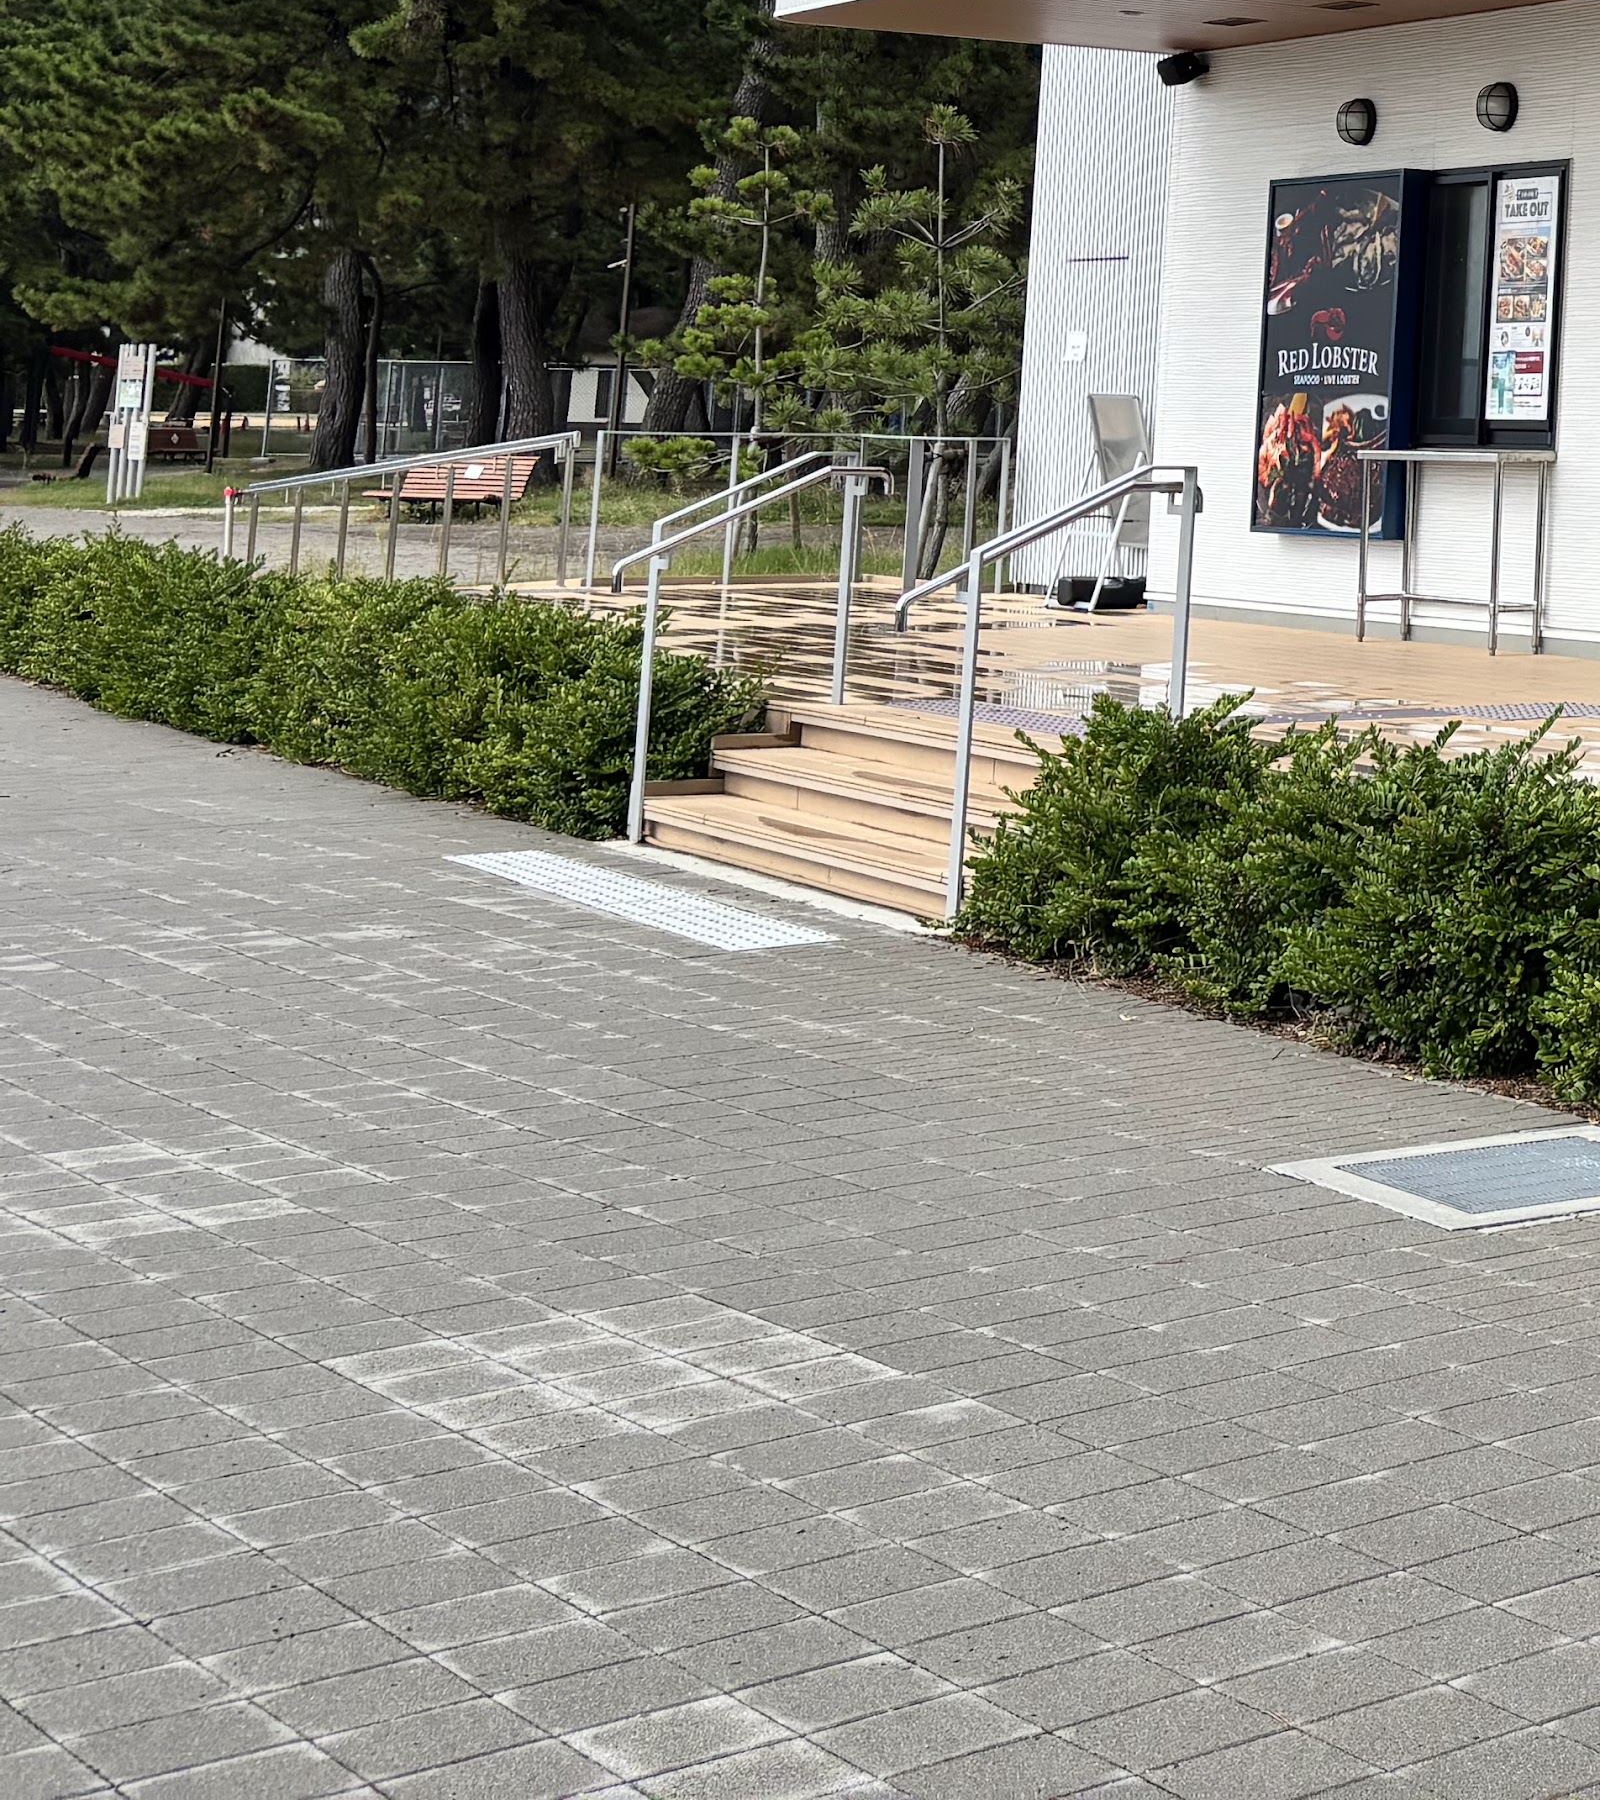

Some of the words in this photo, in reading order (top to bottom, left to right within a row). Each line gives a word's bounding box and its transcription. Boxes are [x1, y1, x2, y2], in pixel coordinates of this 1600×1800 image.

[1505, 203, 1528, 218] TAKE
[1530, 201, 1549, 217] OUT
[1278, 349, 1309, 377] RED
[1312, 343, 1379, 376] LOBSTER
